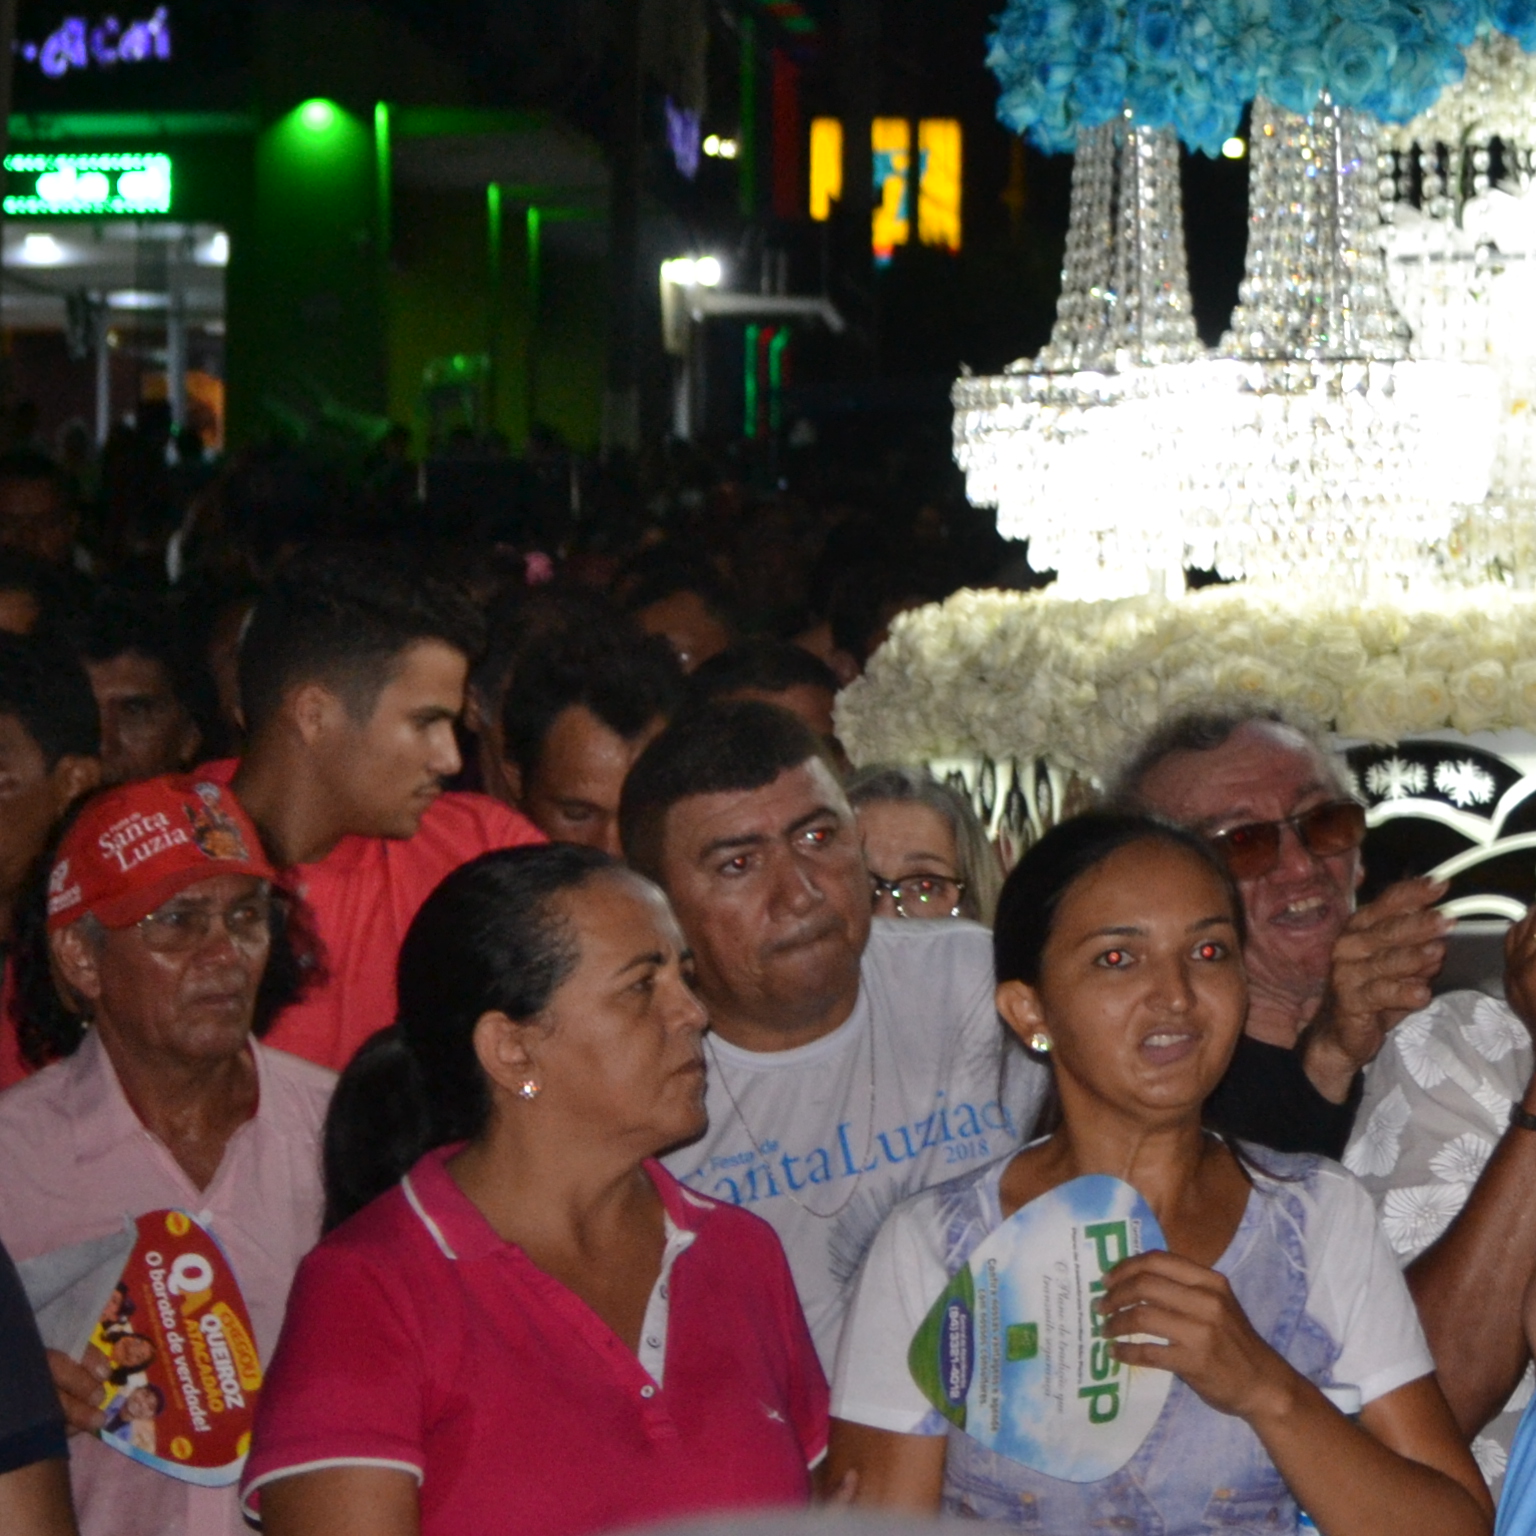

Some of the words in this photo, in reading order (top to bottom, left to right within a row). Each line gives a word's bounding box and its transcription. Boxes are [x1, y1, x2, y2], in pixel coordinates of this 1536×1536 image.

[98, 812, 170, 859] Santa
[115, 827, 189, 873] Luzia
[945, 1139, 991, 1163] 2018
[145, 1250, 163, 1267] O
[148, 1267, 177, 1330] barato
[167, 1330, 185, 1355] de
[199, 1313, 245, 1409] QUEIROZ
[174, 1356, 213, 1433] verdade!
